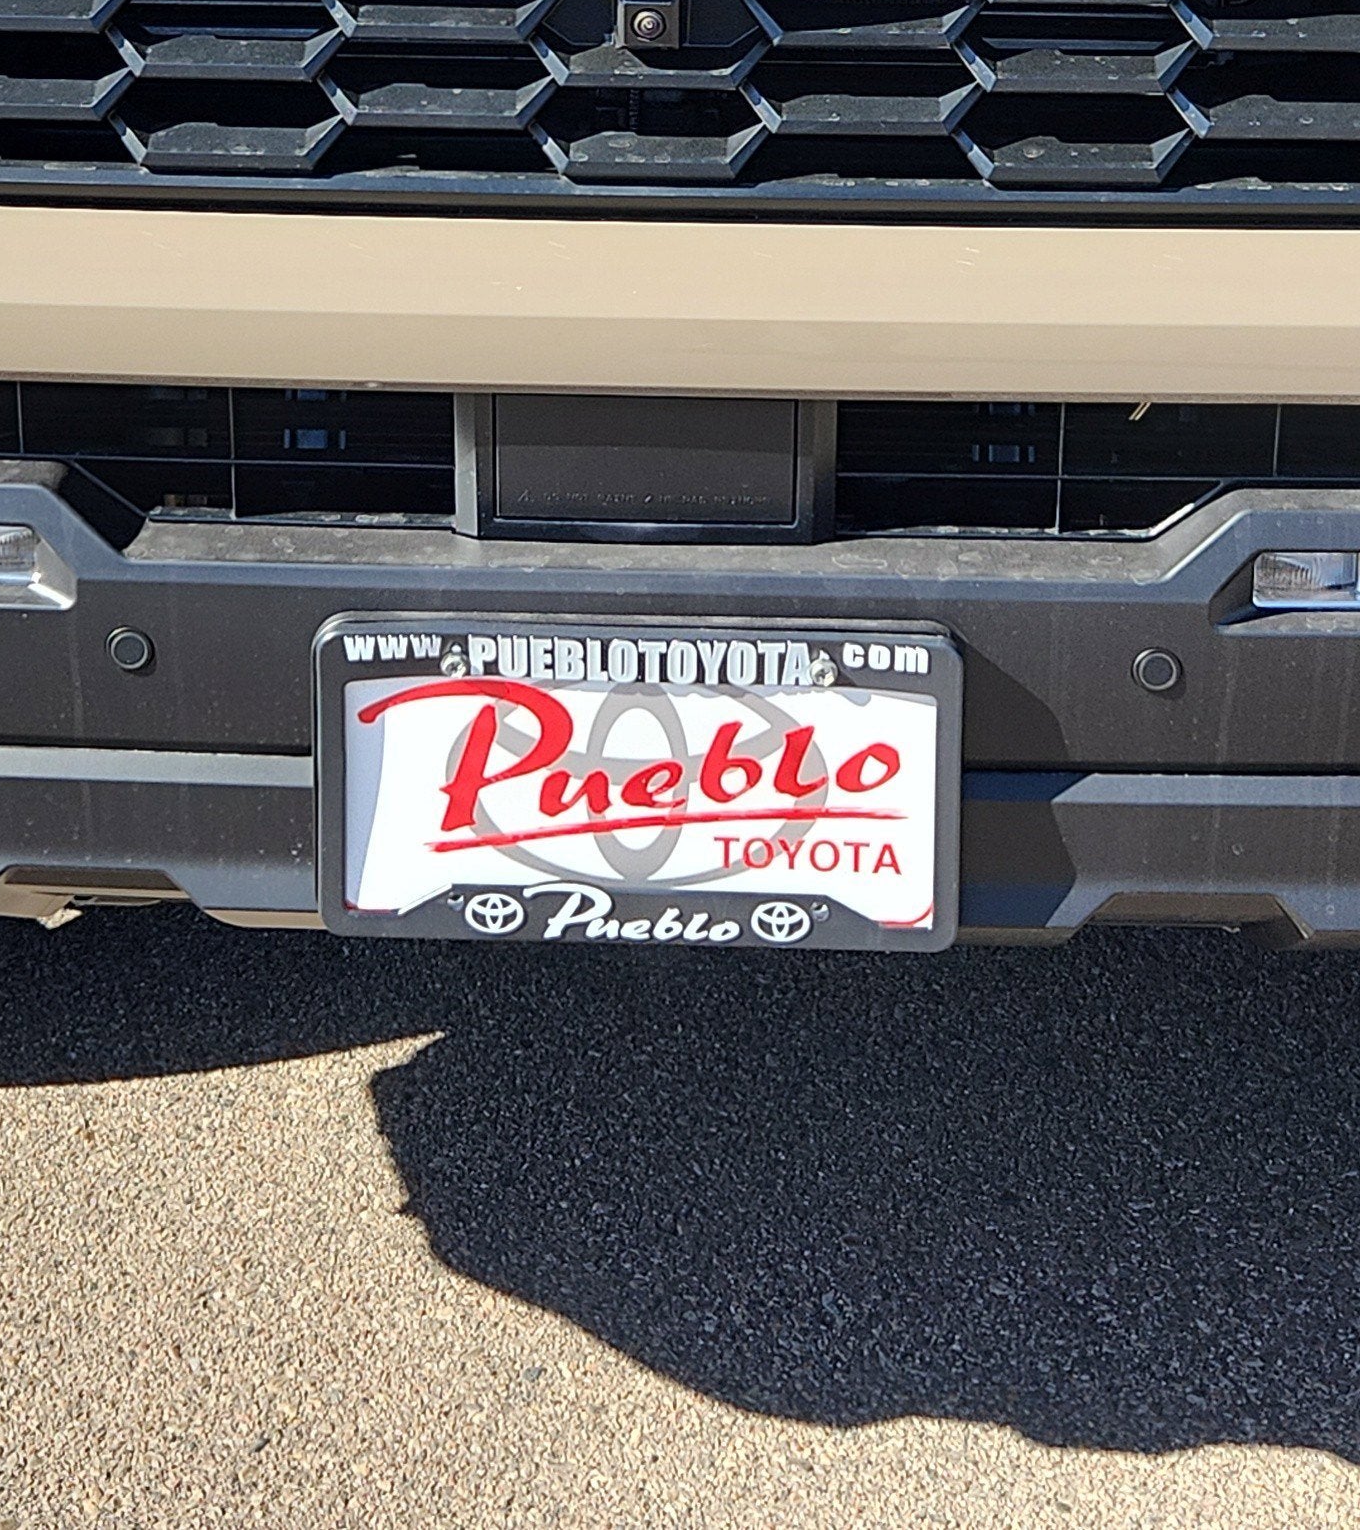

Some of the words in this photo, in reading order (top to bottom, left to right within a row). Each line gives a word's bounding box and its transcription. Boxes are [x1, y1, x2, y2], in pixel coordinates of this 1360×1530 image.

[357, 675, 902, 833] Pueblo
[713, 835, 903, 875] TOYOTA
[522, 881, 742, 942] Pueblo
